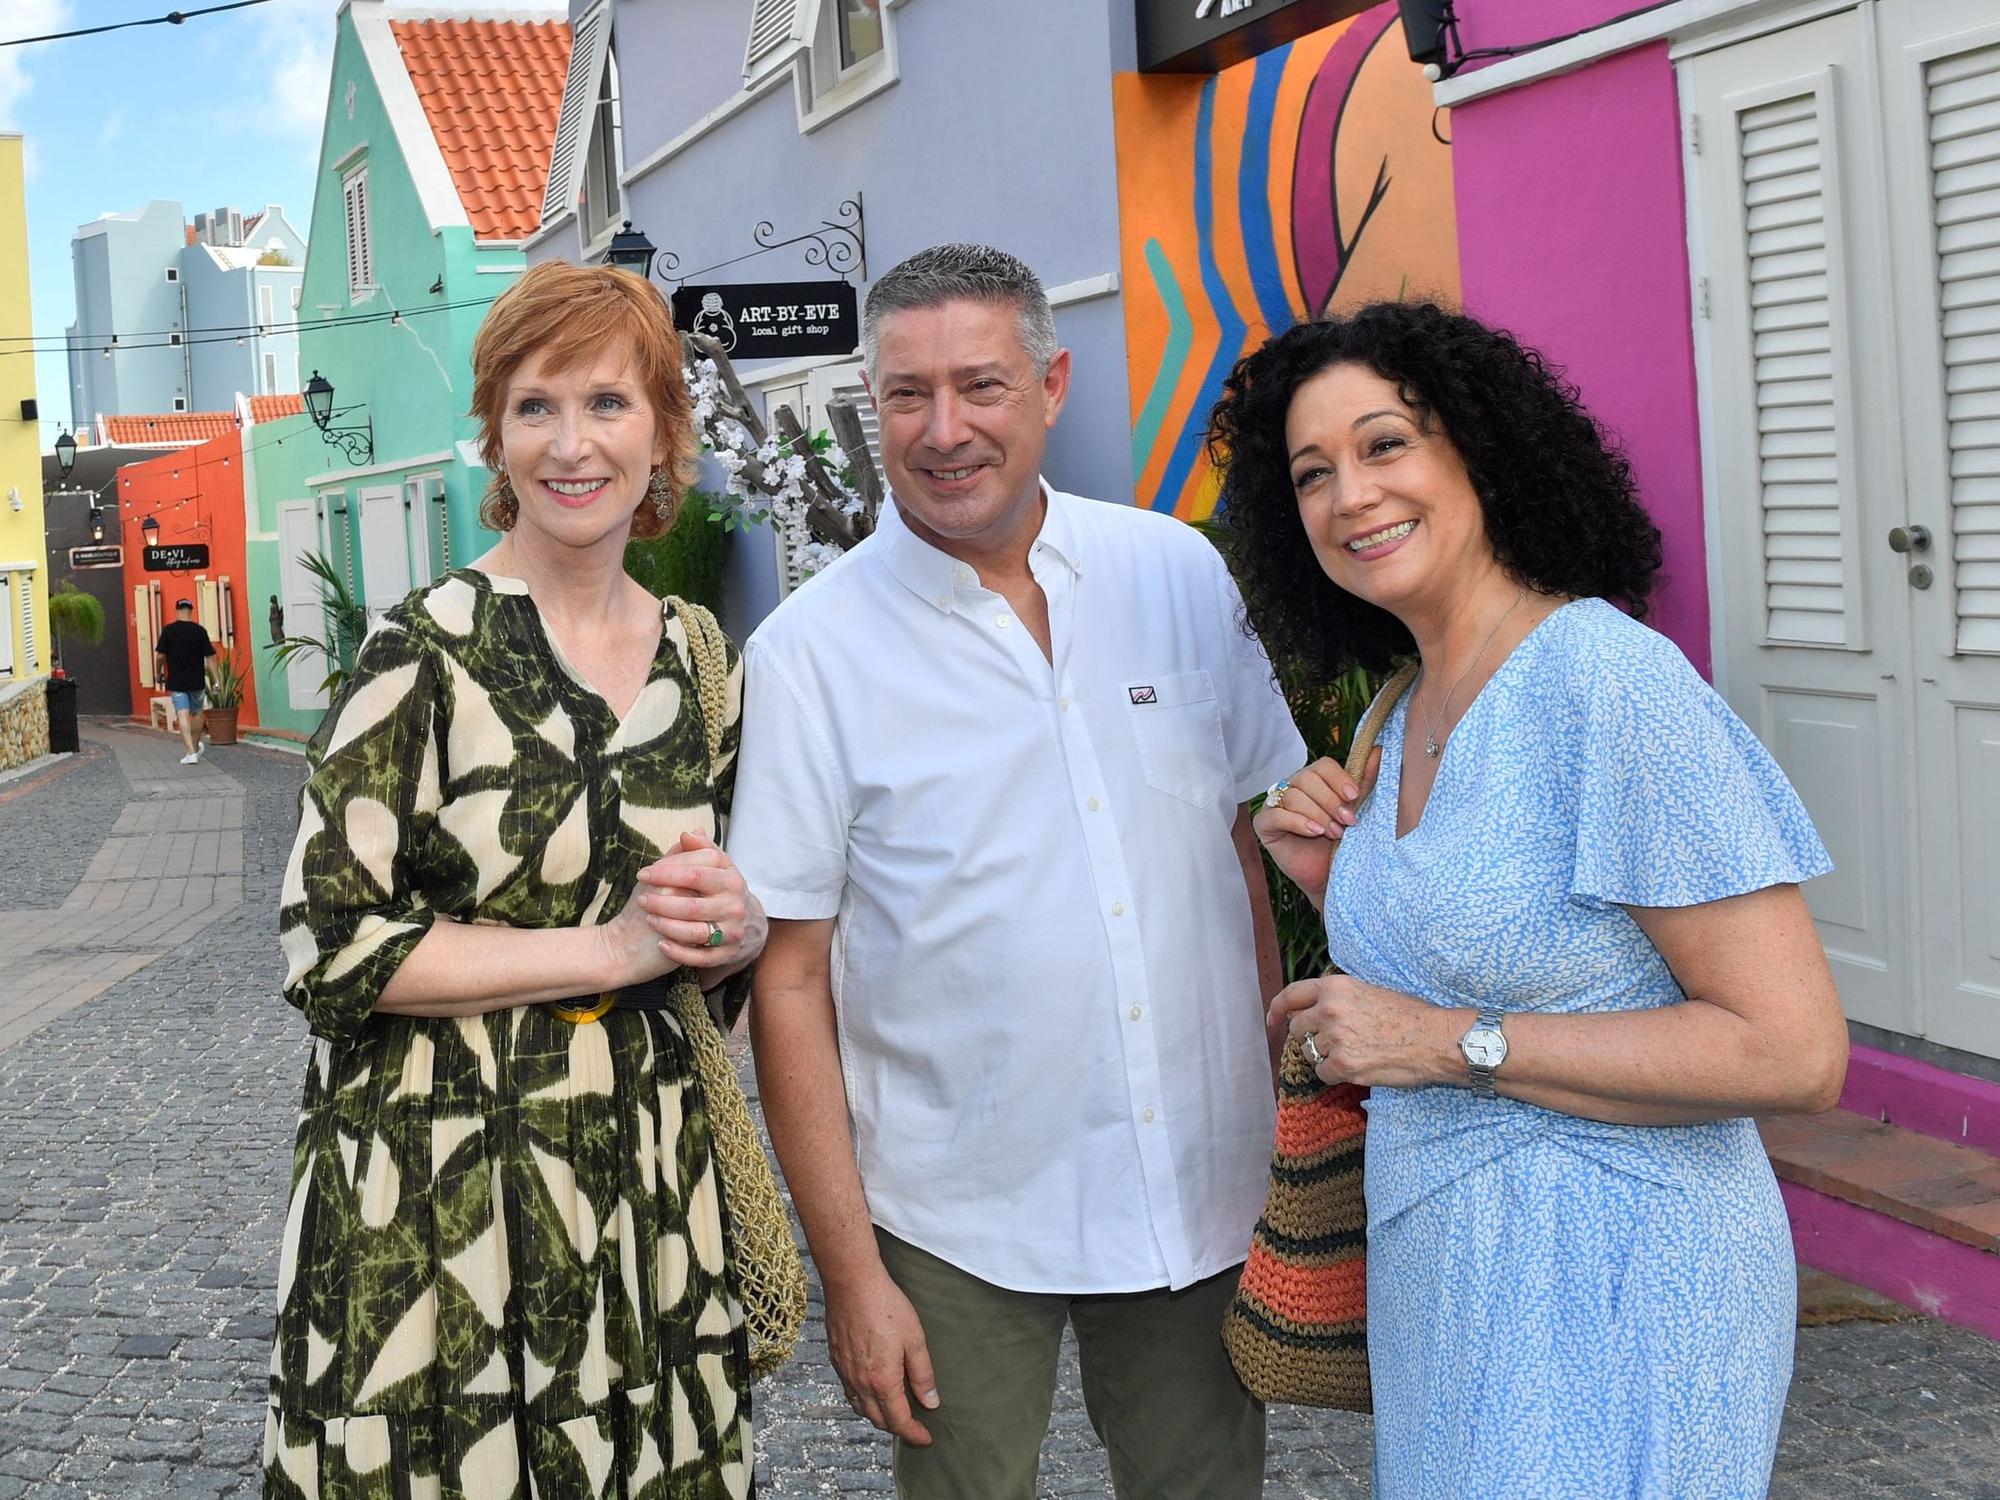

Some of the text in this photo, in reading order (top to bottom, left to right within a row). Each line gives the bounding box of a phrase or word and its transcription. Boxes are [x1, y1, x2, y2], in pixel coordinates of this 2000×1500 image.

[739, 304, 839, 323] ART-BY-EVE
[752, 324, 829, 337] local gift shop
